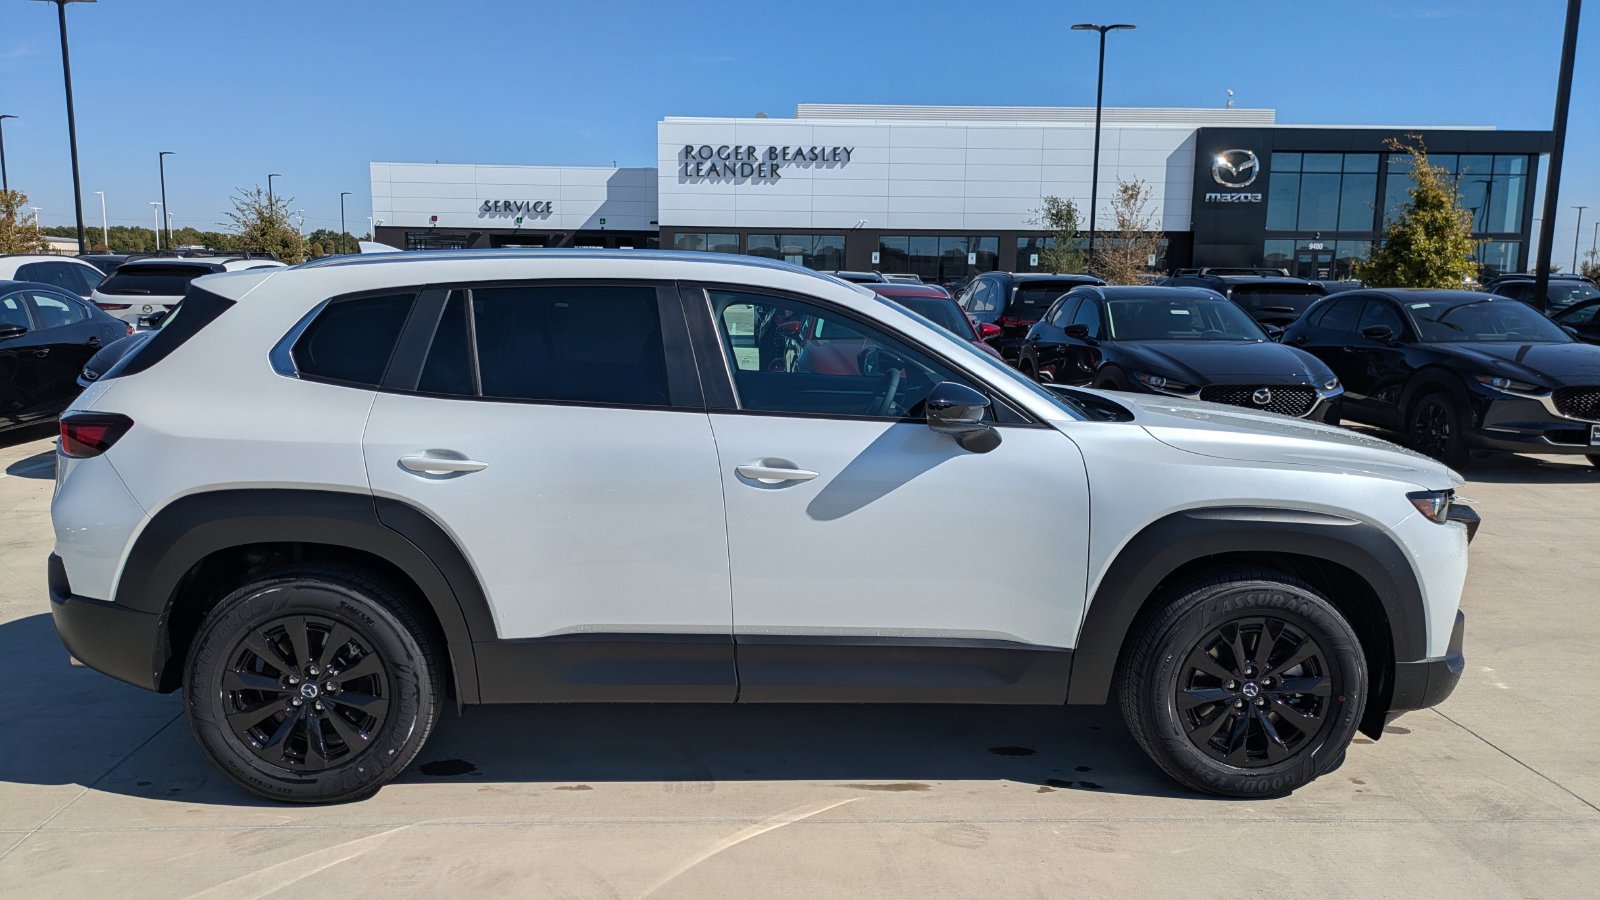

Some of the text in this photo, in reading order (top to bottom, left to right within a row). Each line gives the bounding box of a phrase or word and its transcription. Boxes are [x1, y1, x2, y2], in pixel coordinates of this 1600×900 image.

[684, 145, 855, 162] ROGER BEASLEY
[684, 161, 782, 178] LEANDER
[1205, 192, 1262, 203] mazda
[483, 199, 553, 214] SERVICE
